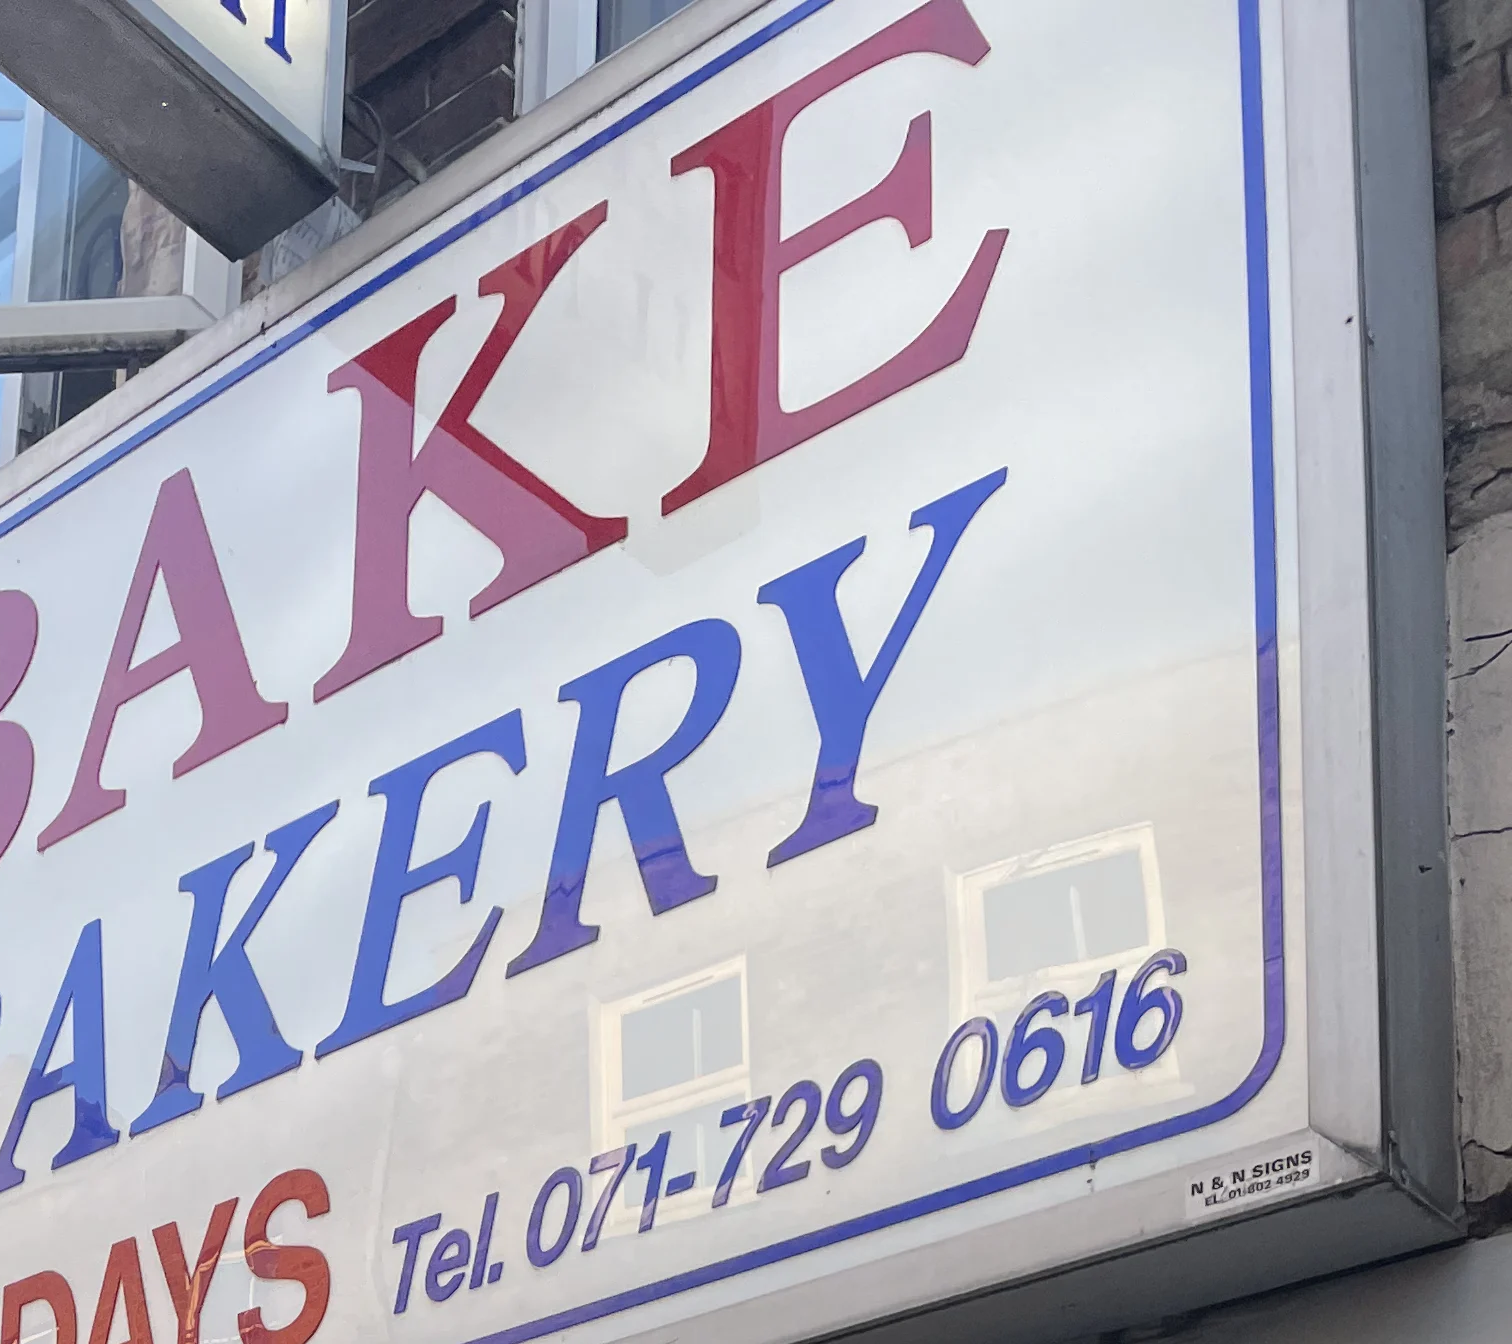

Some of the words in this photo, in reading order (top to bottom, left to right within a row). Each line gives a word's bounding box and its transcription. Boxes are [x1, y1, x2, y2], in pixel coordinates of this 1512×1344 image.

[392, 1191, 505, 1315] Tel.
[526, 1058, 884, 1269] 071-729
[929, 948, 1188, 1131] 0616
[1191, 1181, 1204, 1197] N
[1212, 1176, 1224, 1191] &
[1232, 1169, 1245, 1184] N
[1252, 1150, 1313, 1179] SIGNS
